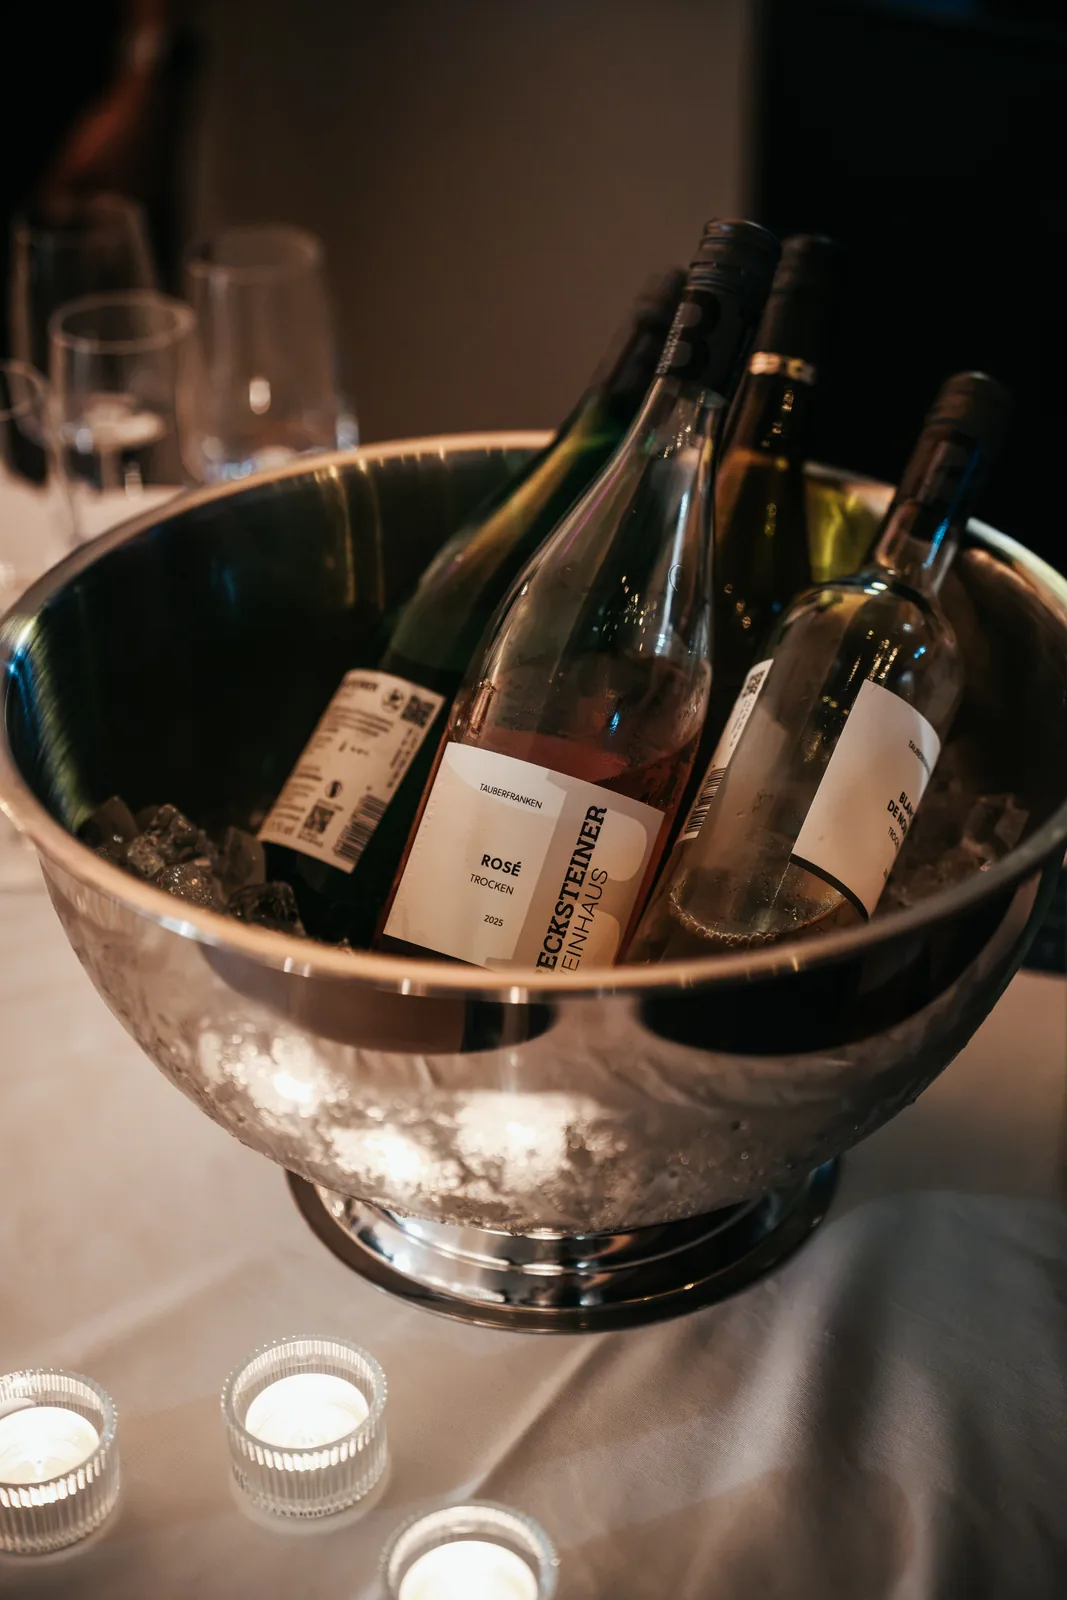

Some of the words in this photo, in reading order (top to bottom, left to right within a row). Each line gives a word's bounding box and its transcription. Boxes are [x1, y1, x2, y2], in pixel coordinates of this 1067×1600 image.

[479, 783, 543, 809] TAUBERFRANKEN
[887, 800, 899, 818] DE
[480, 854, 522, 877] ROSÉ
[470, 873, 515, 895] TROCKEN
[535, 804, 608, 973] ECKSTEINER
[483, 914, 504, 927] 2025
[560, 868, 609, 974] EINHAUS
